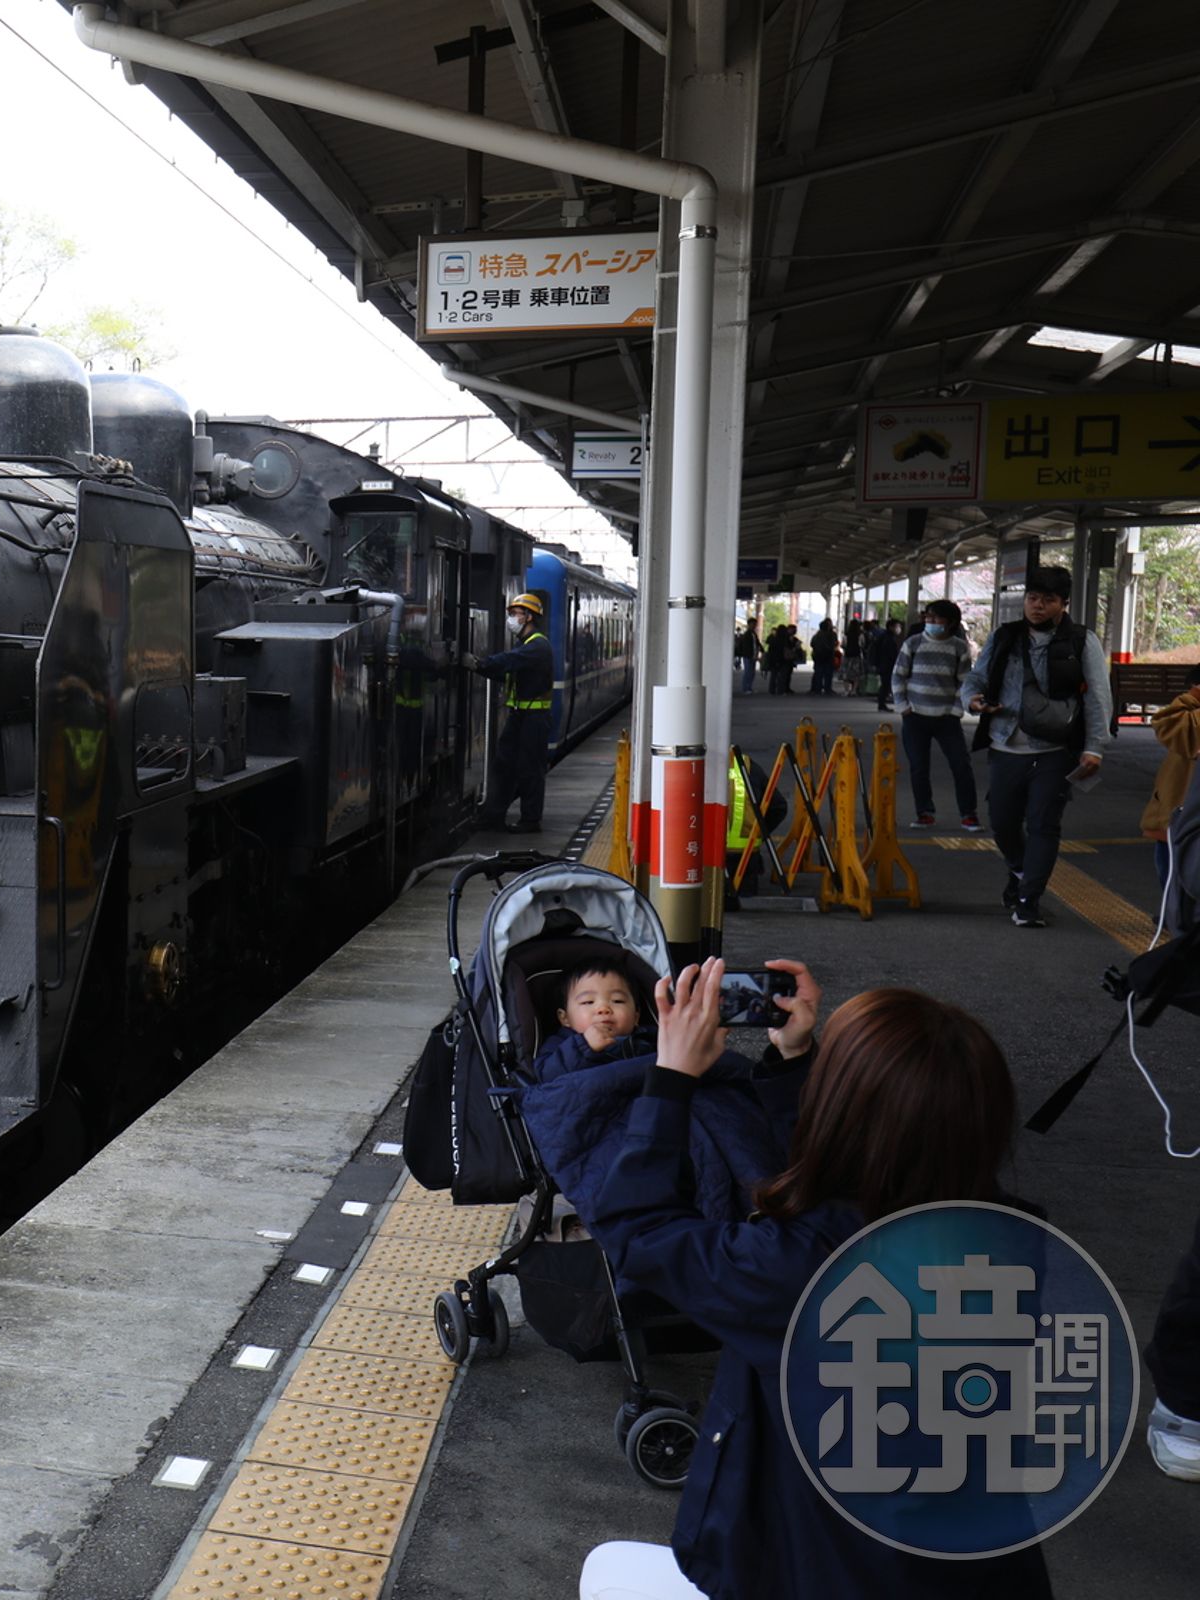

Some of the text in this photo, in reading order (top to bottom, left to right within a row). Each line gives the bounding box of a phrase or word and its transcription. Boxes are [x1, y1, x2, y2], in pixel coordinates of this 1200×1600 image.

[479, 249, 657, 279] 特急 スペーシア
[529, 286, 610, 307] 乗車位置
[462, 311, 493, 323] Cars
[1004, 413, 1121, 460] 出口
[1037, 465, 1082, 486] Exit
[1084, 466, 1112, 478] 出口
